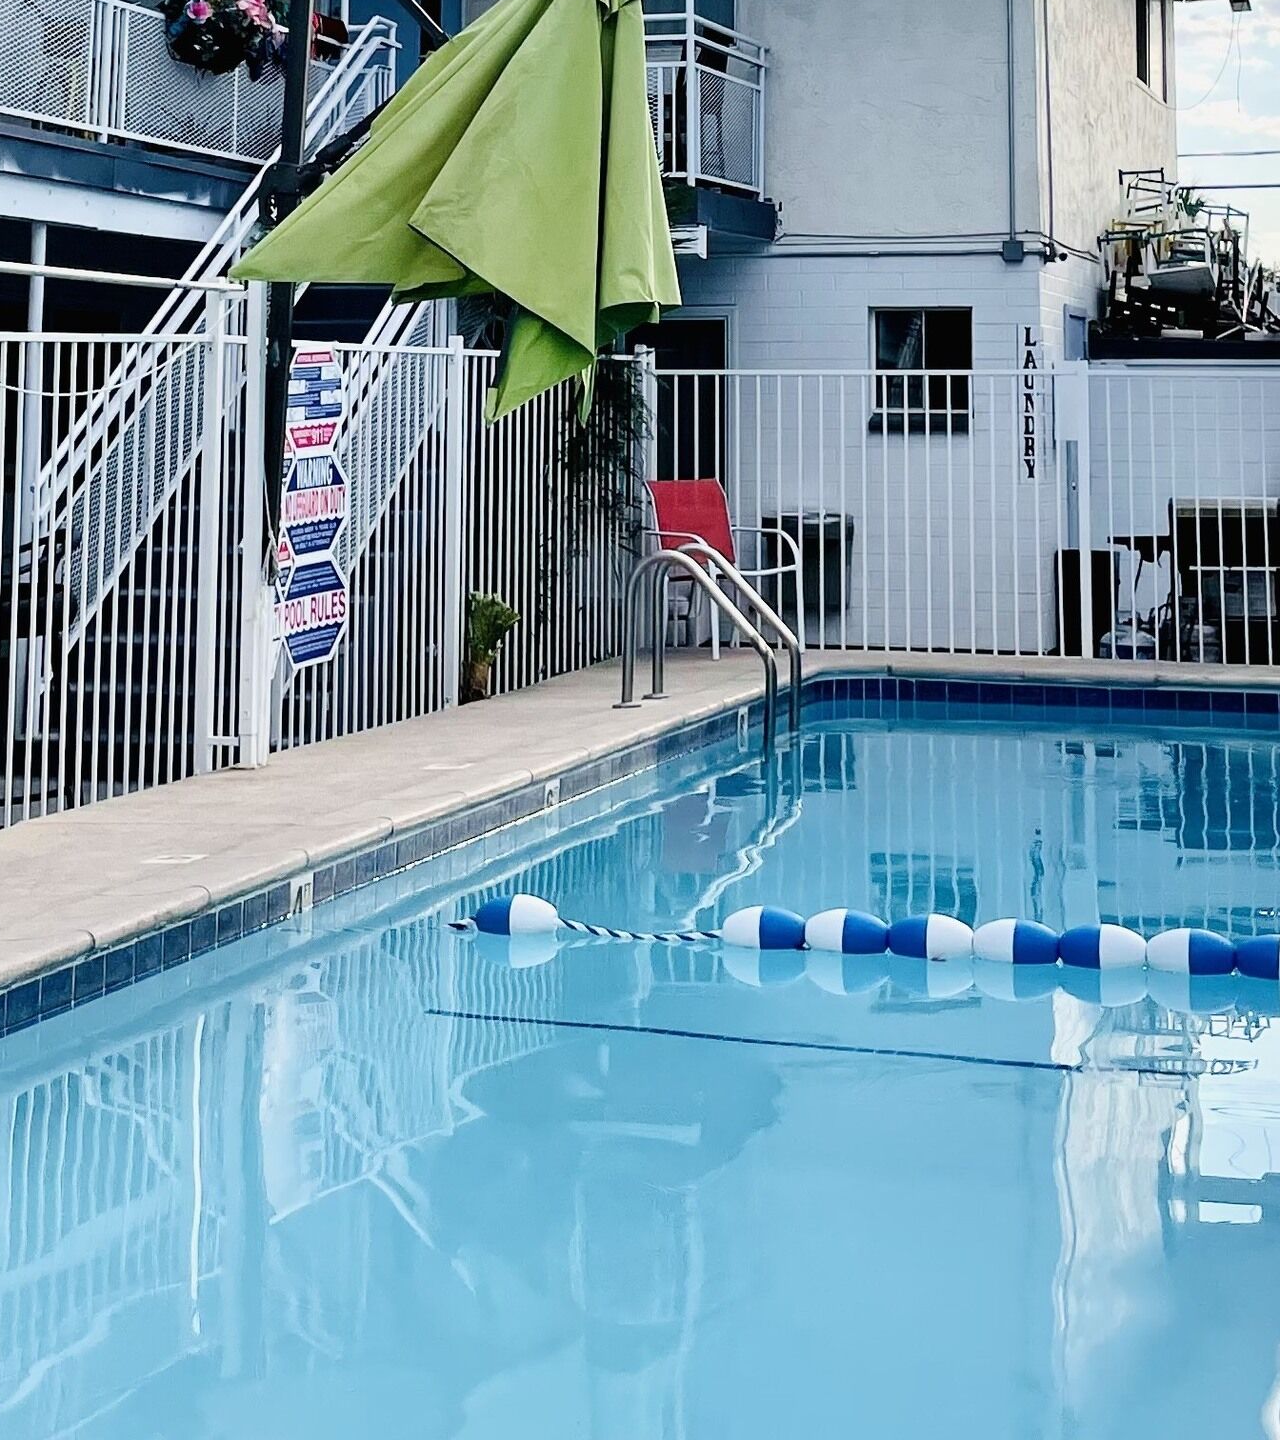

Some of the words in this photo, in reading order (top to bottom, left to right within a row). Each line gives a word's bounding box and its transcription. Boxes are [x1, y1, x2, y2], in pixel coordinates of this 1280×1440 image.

[1023, 326, 1038, 479] LAUNDRY
[296, 457, 333, 490] WARNING
[284, 600, 308, 630] POOL
[310, 591, 346, 624] RULES
